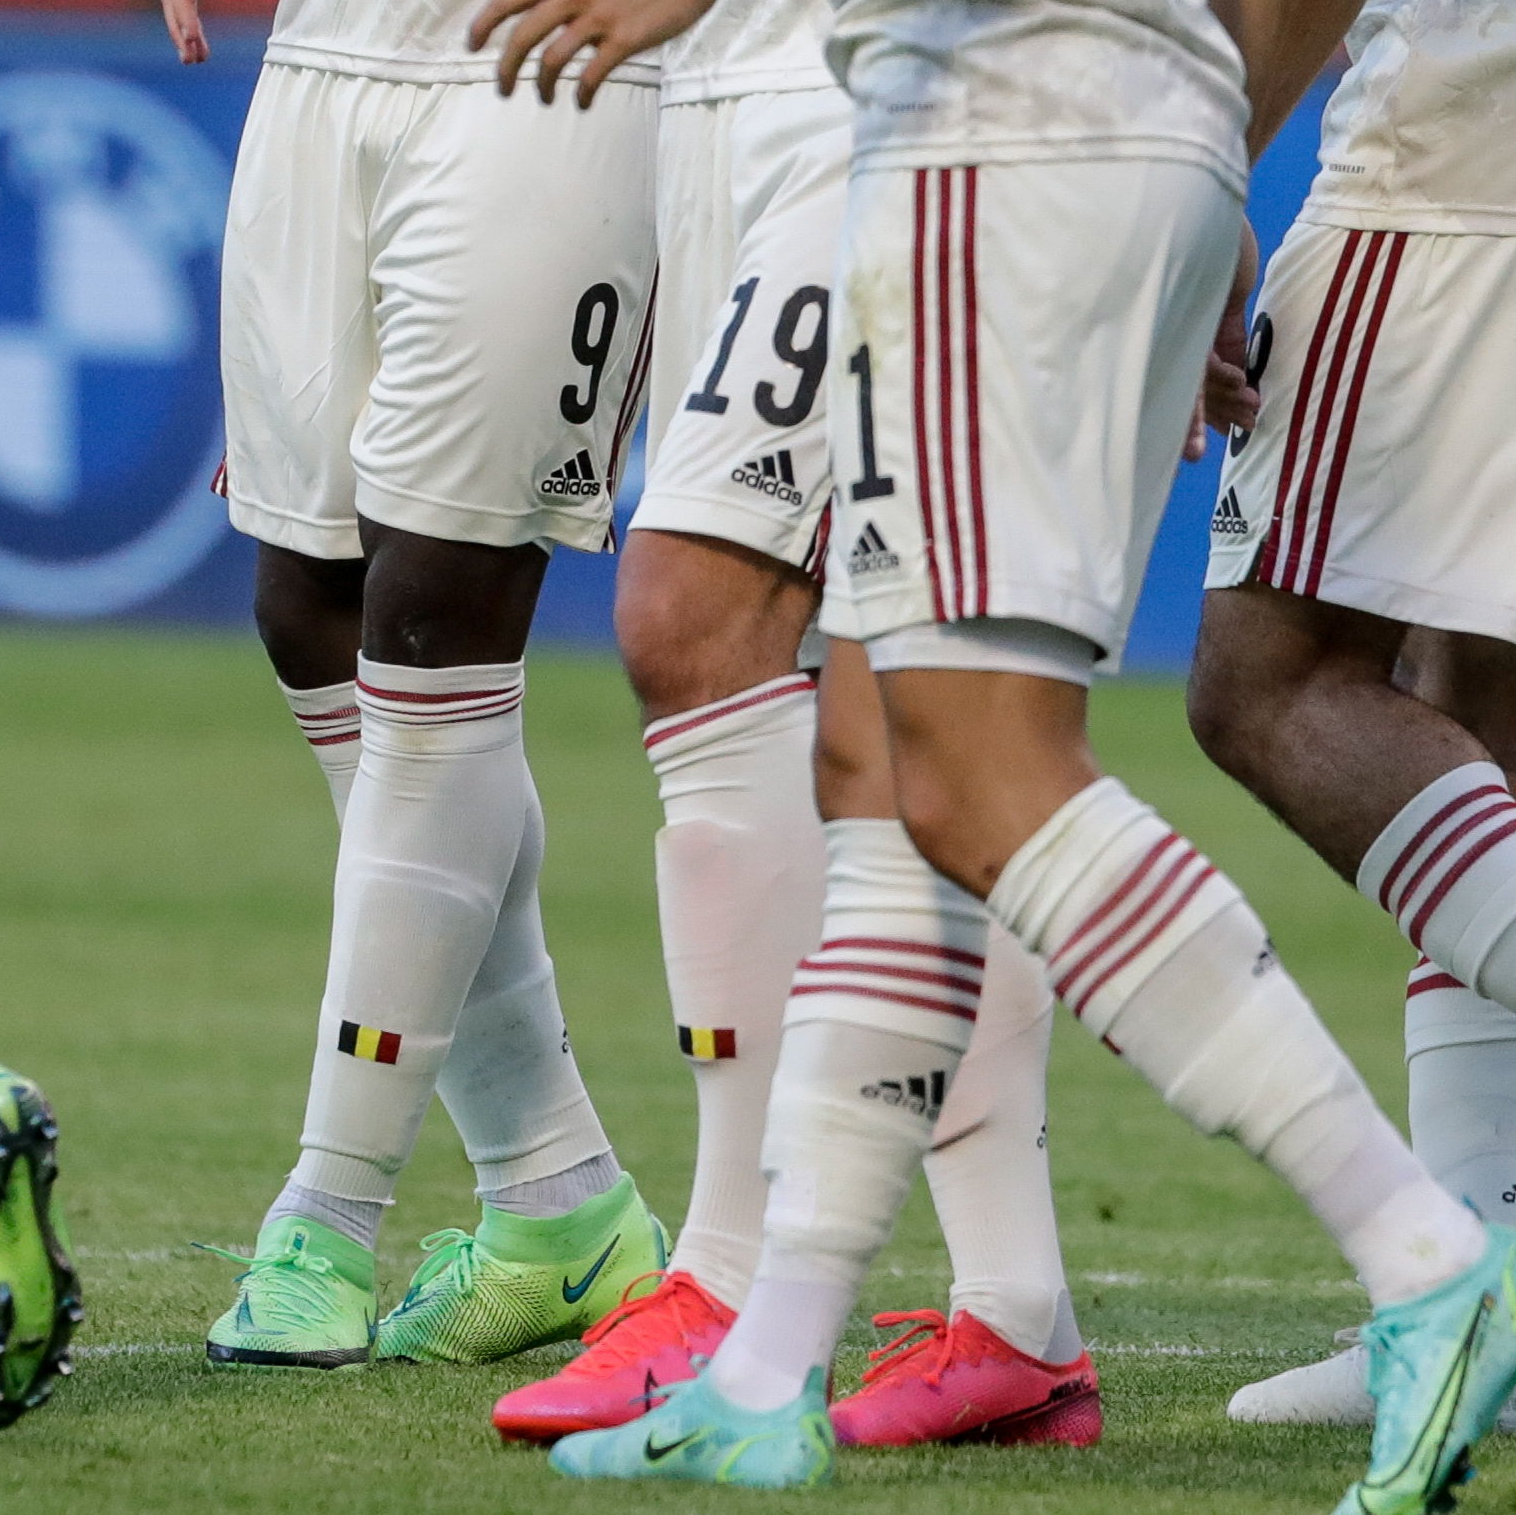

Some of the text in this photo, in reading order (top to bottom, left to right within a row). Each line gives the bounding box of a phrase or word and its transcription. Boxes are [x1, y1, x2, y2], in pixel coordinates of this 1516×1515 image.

[559, 282, 620, 426] 9
[684, 275, 829, 428] 19
[541, 477, 602, 497] adidas
[731, 469, 803, 506] adidas
